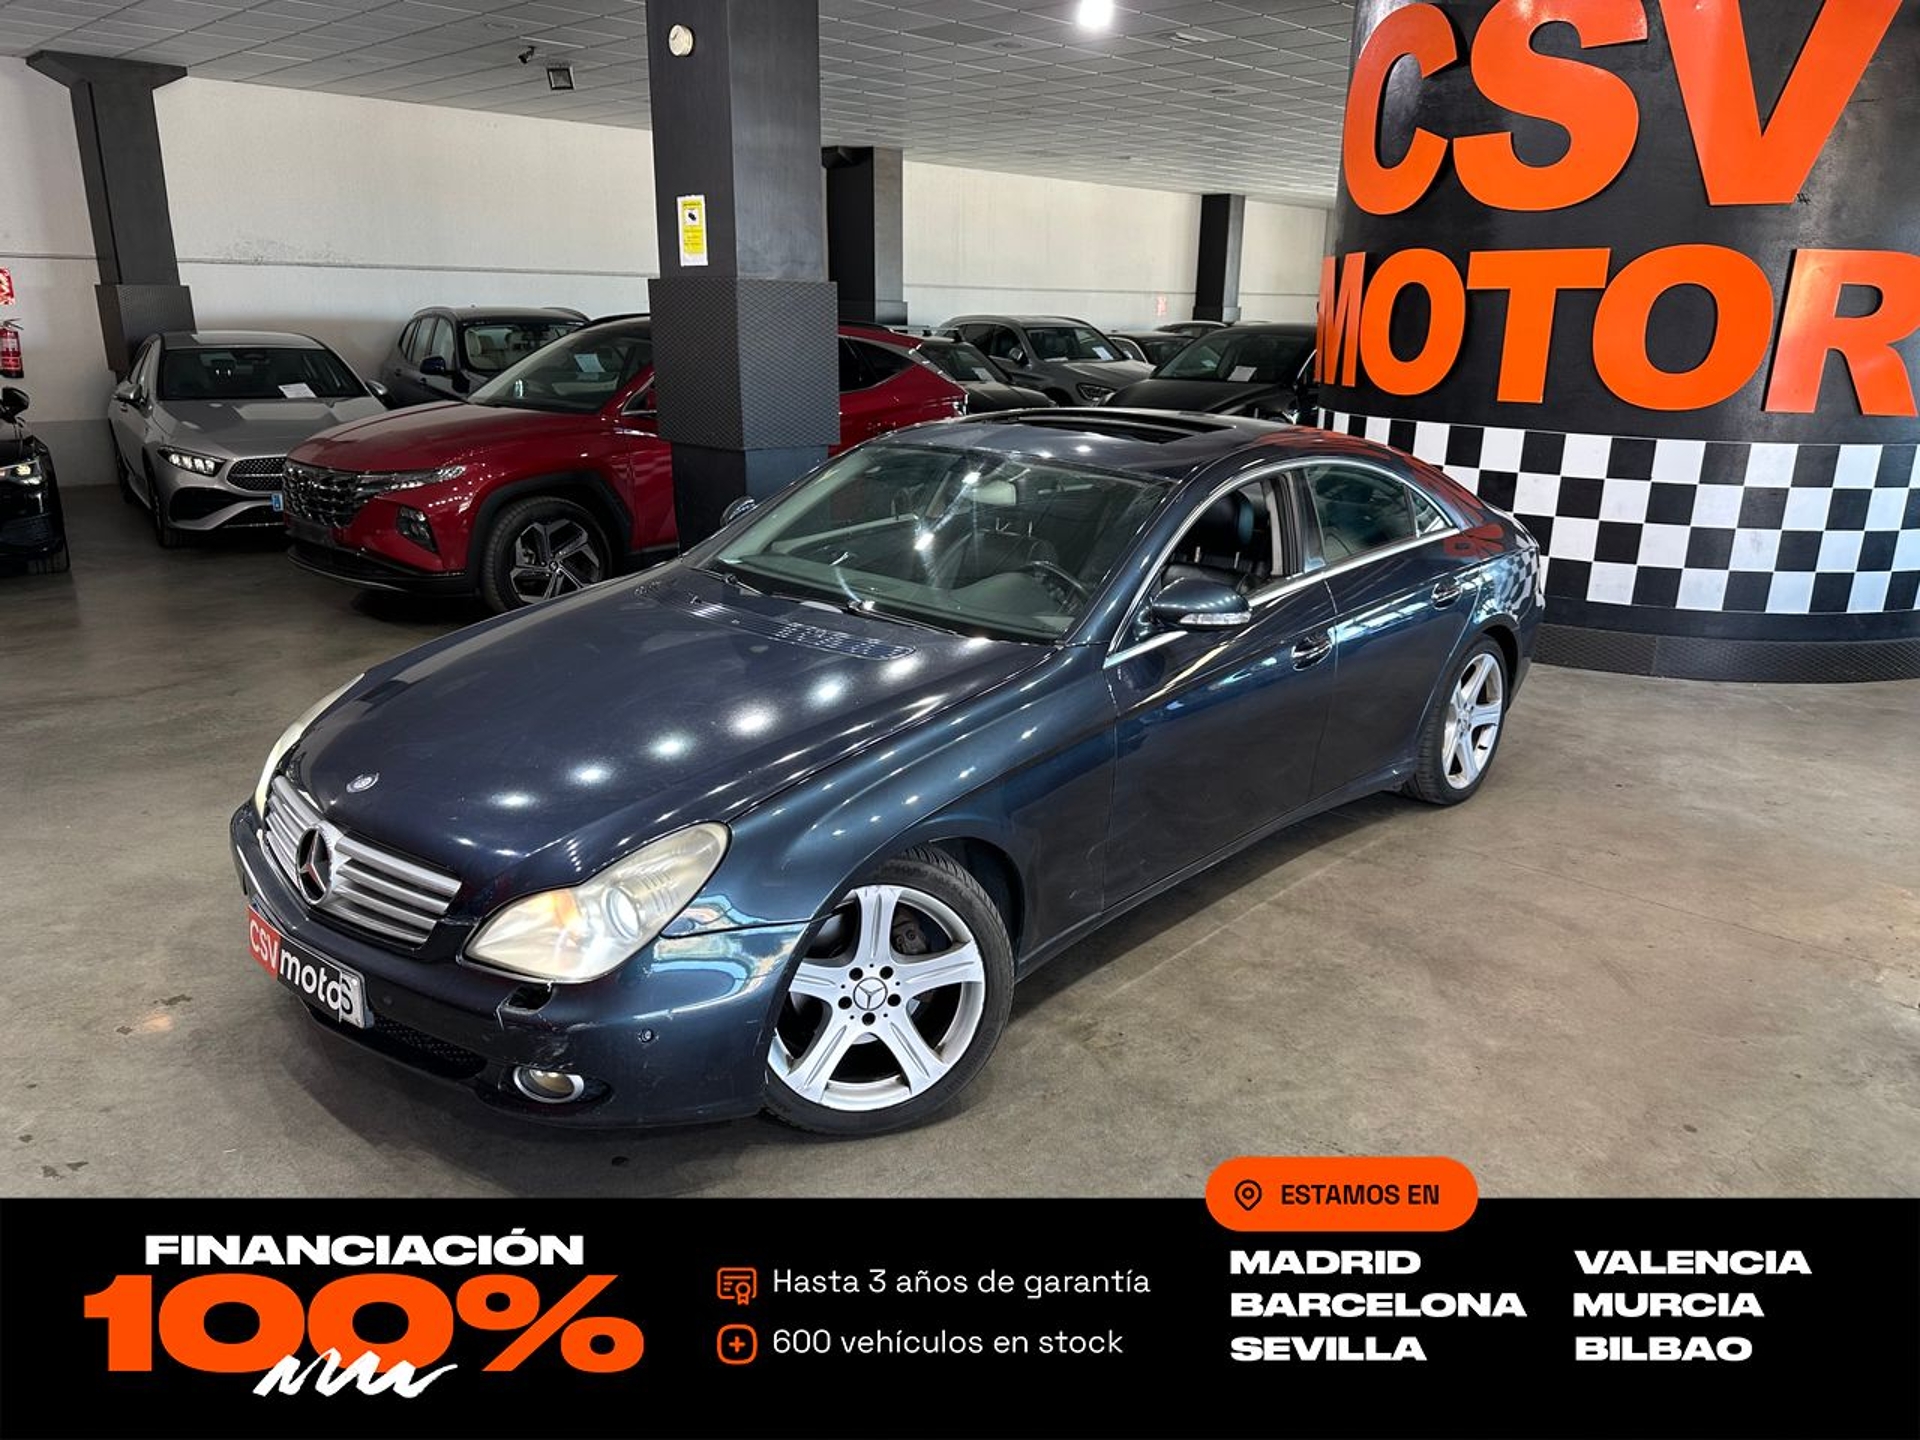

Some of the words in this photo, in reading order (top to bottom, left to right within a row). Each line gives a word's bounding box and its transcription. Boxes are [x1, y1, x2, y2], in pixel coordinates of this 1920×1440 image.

[1343, 0, 1900, 216] CSV
[1315, 243, 1920, 417] MOTOR
[249, 919, 279, 970] CSV
